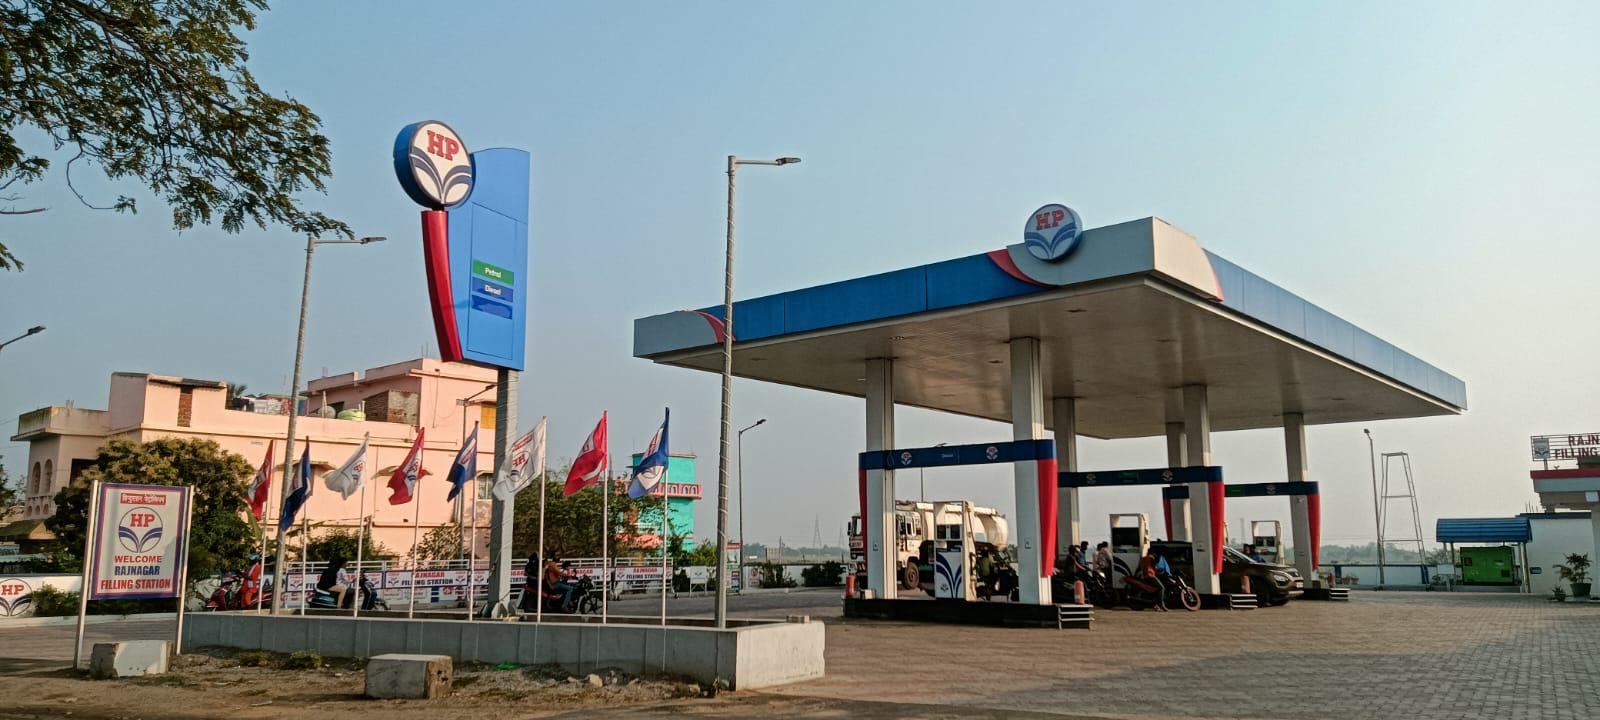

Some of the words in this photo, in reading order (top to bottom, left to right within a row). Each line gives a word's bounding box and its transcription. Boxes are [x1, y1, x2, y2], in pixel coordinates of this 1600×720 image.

[427, 130, 459, 161] HP
[1036, 209, 1065, 231] HP
[484, 267, 502, 278] Petrol
[1554, 447, 1598, 458] FILLING
[130, 513, 155, 527] HP
[115, 555, 162, 563] WELCOME
[115, 565, 160, 575] RAJNAGAR
[101, 579, 133, 589] FILLING
[135, 578, 171, 589] STATION
[1, 585, 25, 595] HP
